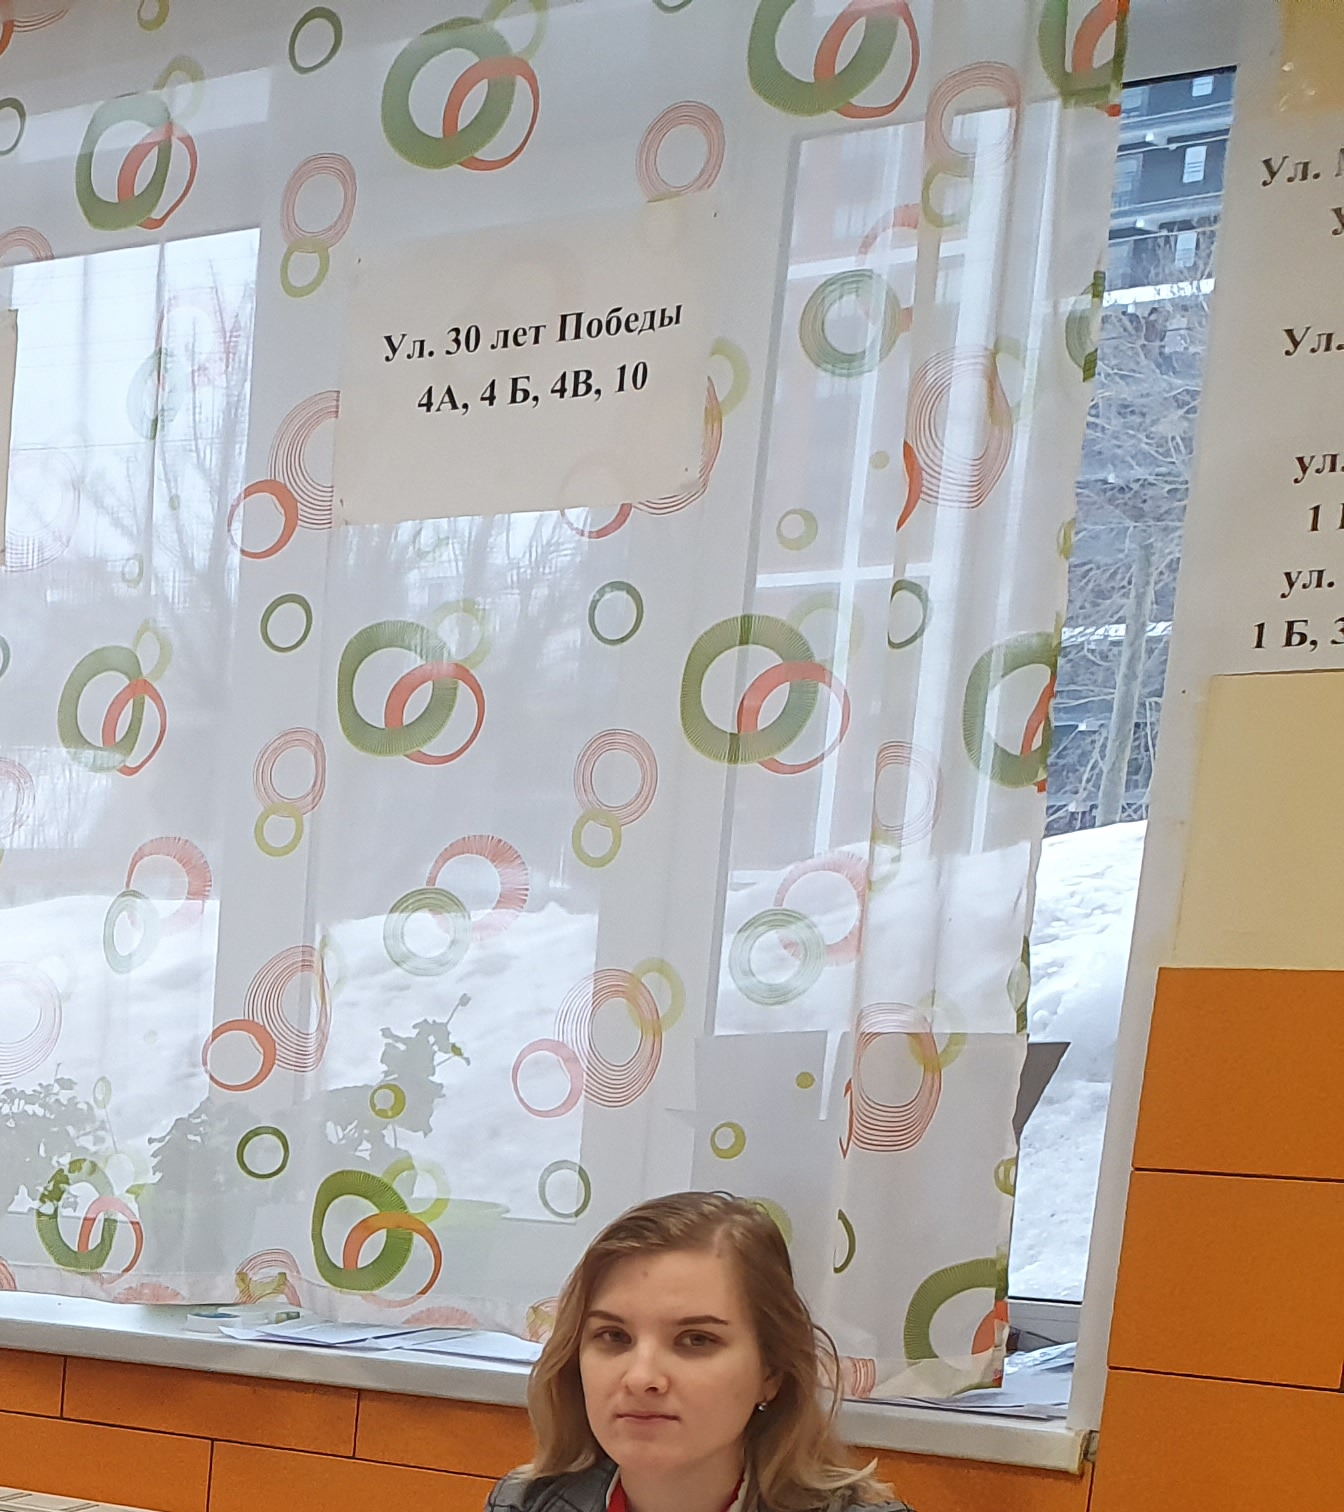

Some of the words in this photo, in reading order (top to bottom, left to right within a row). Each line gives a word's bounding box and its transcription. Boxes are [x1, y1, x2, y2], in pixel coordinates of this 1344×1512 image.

[1262, 156, 1320, 187] Ул.
[383, 334, 435, 362] Ул.
[445, 324, 481, 356] 30
[490, 323, 547, 351] лет
[556, 304, 683, 342] Победы
[1282, 326, 1344, 356] Ул.
[417, 385, 470, 415] 4А,
[479, 378, 497, 407] 4
[507, 375, 540, 409] Б,
[550, 369, 602, 401] 4В,
[614, 361, 649, 392] 10
[1308, 504, 1322, 532] 1
[1280, 568, 1335, 599] ул.
[1253, 622, 1266, 649] 1
[1282, 619, 1318, 652] Б,
